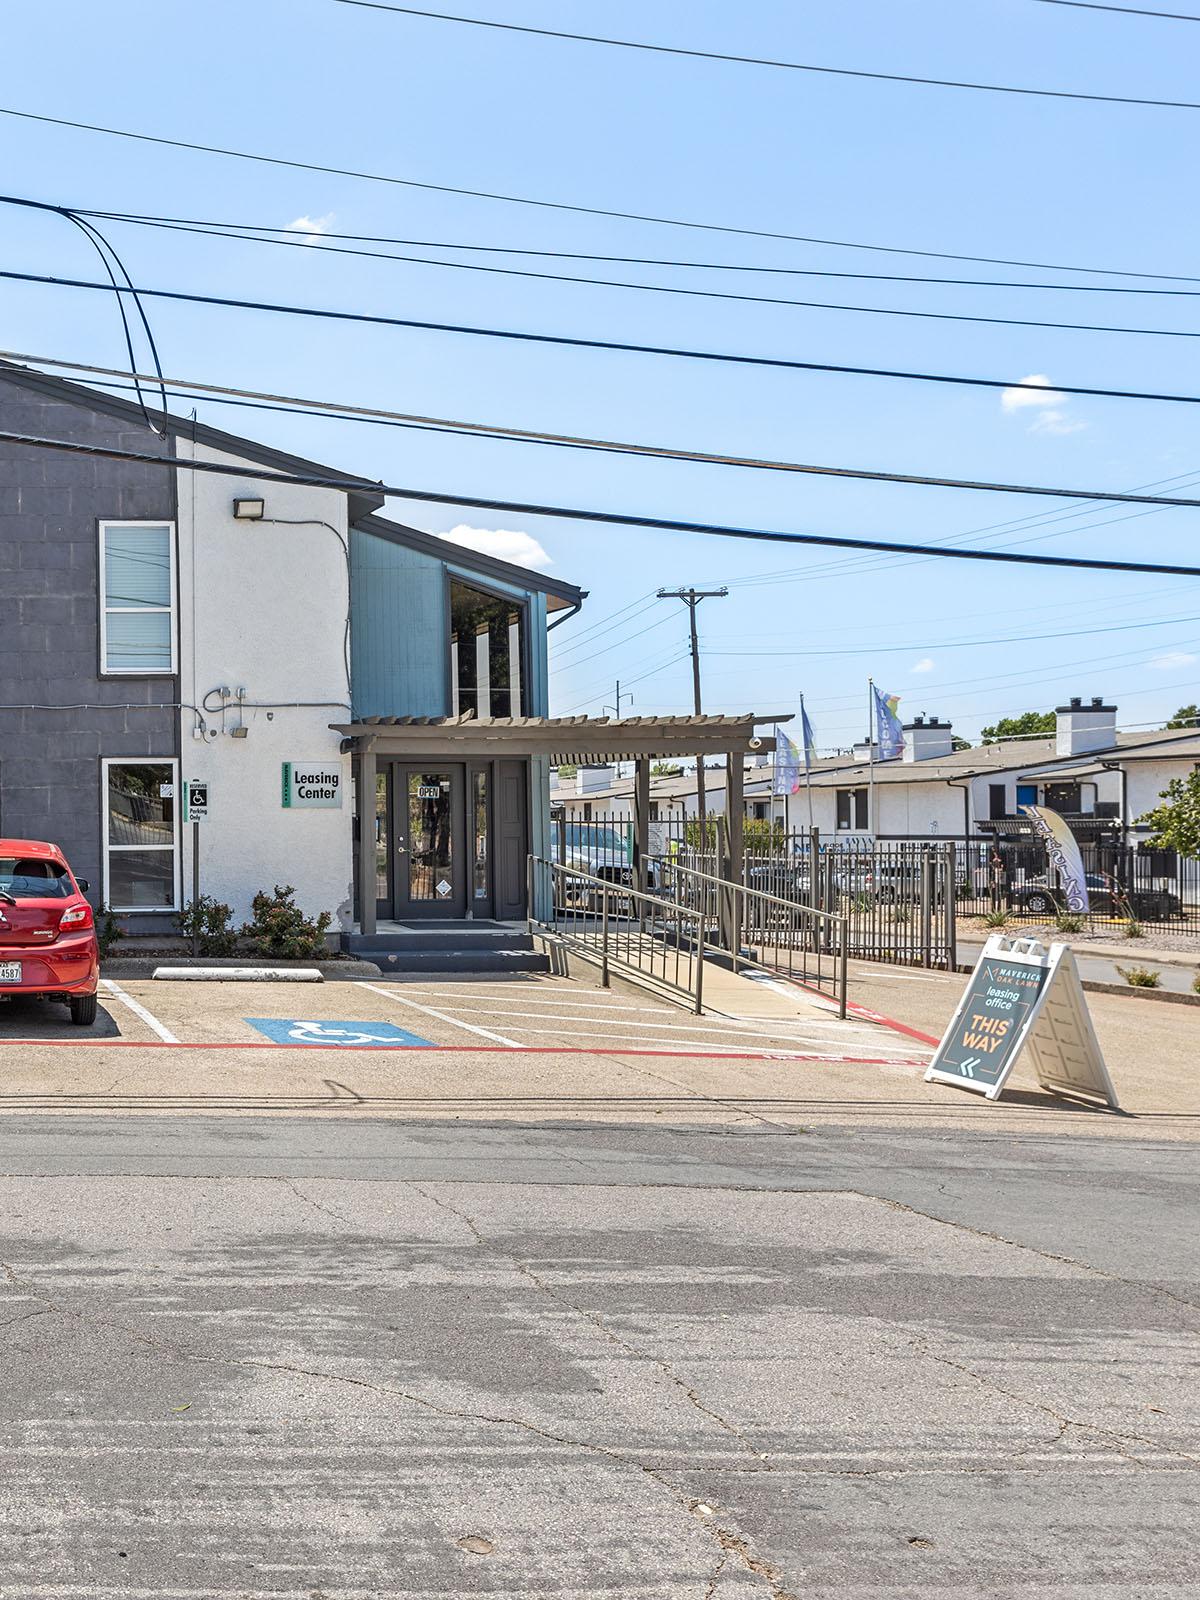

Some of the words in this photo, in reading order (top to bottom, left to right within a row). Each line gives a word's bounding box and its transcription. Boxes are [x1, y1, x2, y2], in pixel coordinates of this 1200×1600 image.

[294, 770, 339, 787] Leasing
[297, 785, 336, 799] Center
[418, 787, 438, 797] OPEN
[996, 975, 1013, 985] OAK
[1015, 978, 1040, 990] LAWN
[999, 968, 1042, 982] MAVERICK
[986, 985, 1020, 1002] leasing
[985, 997, 1012, 1010] office
[971, 1014, 1011, 1037] THIS
[961, 1031, 1003, 1054] WAY
